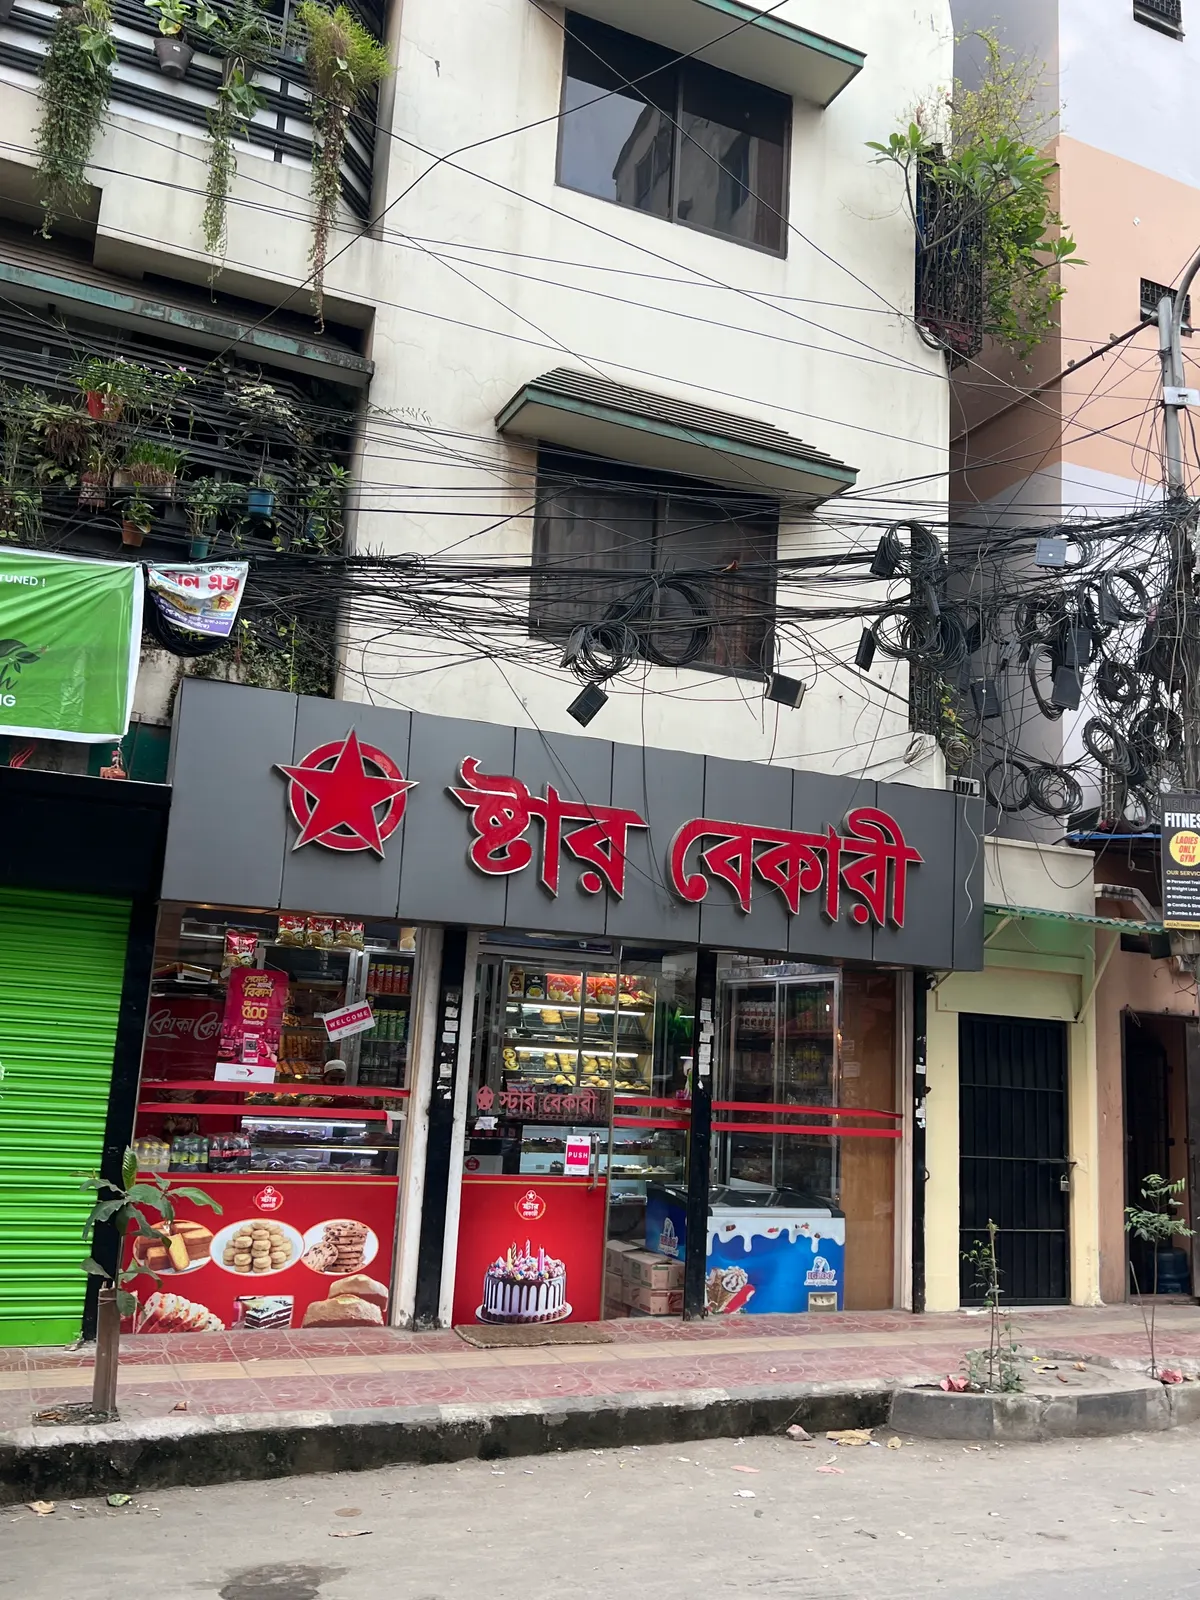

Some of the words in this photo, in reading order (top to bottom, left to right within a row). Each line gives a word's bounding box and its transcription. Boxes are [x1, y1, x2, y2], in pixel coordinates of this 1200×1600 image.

[1176, 836, 1199, 845] LADIES
[1179, 845, 1196, 854] ONLY
[1180, 854, 1196, 863] GYM
[667, 806, 926, 929] বেকারী
[329, 1010, 369, 1028] WELCOME
[568, 1151, 588, 1159] PUSH
